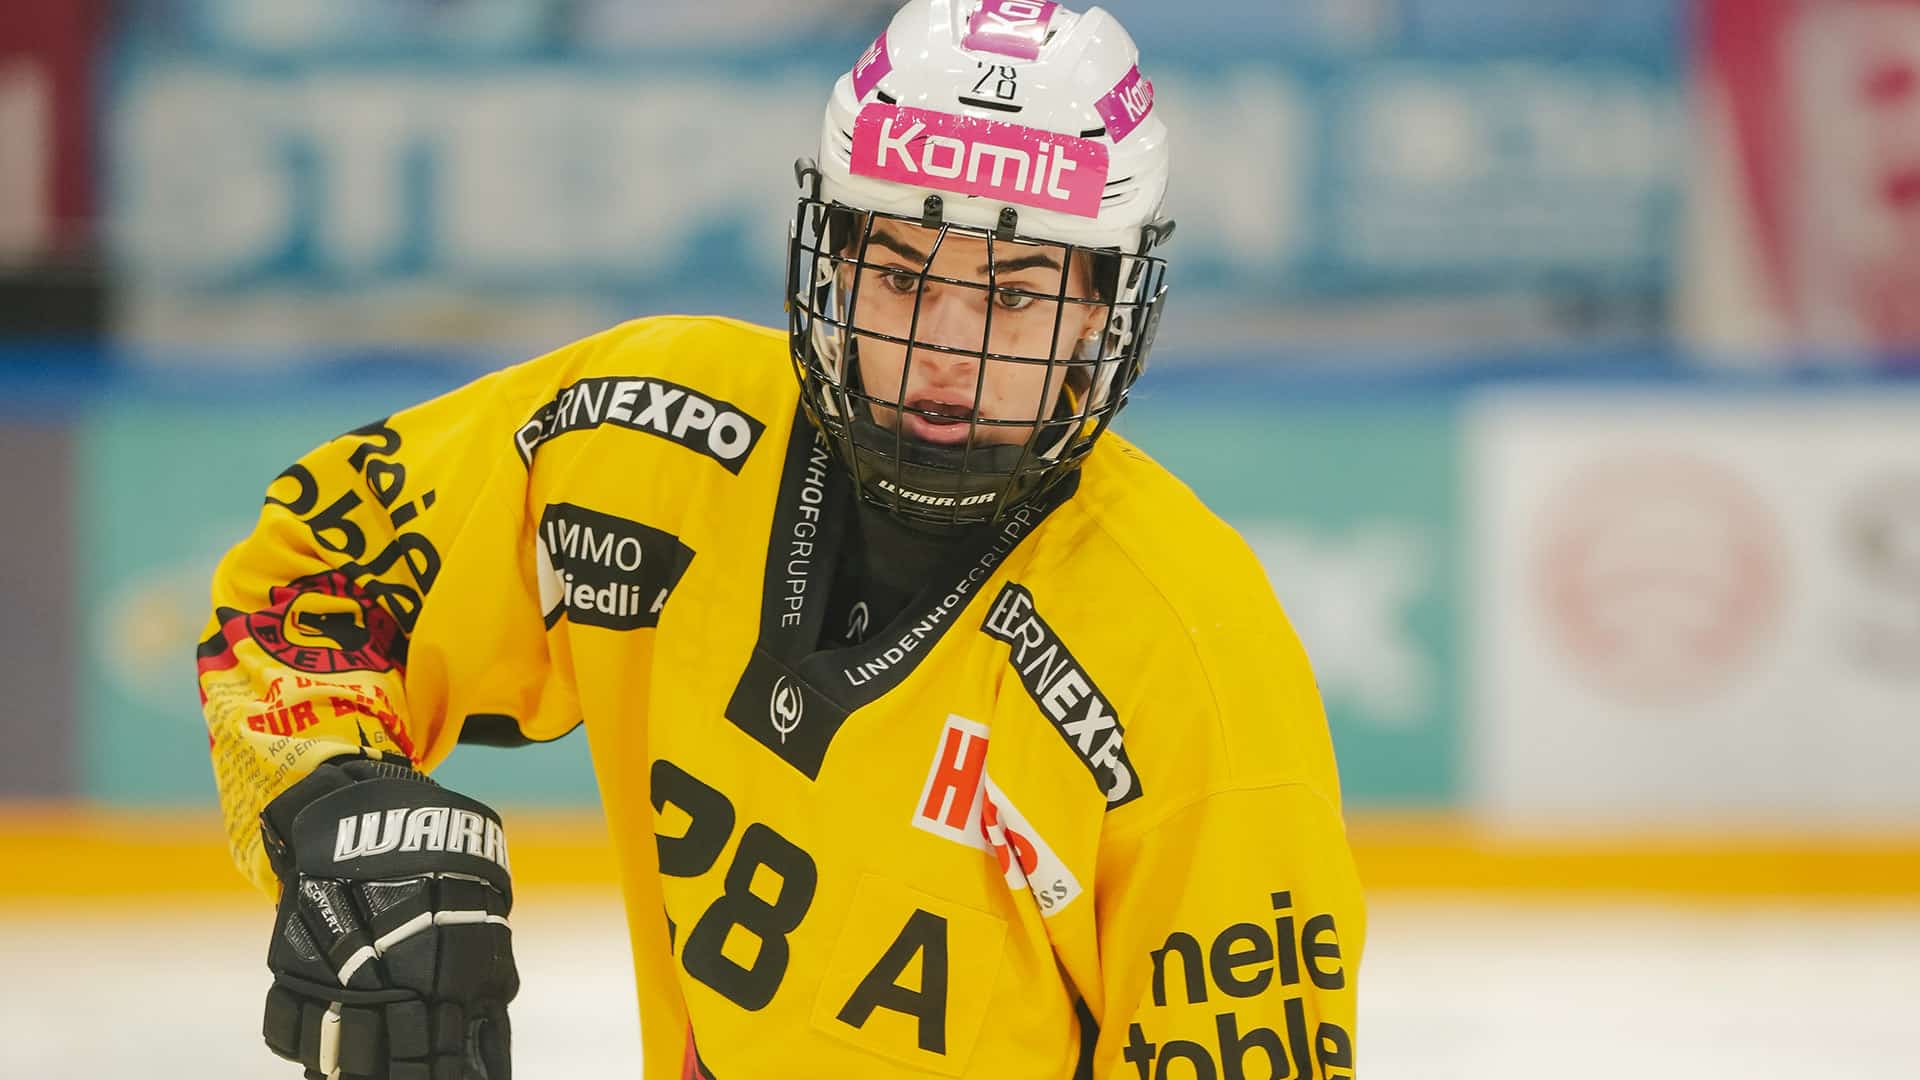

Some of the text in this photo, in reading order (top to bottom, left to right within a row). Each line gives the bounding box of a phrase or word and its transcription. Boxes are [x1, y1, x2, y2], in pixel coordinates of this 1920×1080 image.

[980, 0, 1045, 38] Ko
[972, 61, 1017, 101] 28
[876, 117, 1078, 201] Komit
[516, 381, 751, 466] BRNEXPO
[547, 519, 642, 572] IMMO
[557, 570, 640, 616] iedli
[247, 699, 320, 737] FÜR
[650, 759, 818, 1012] 28
[836, 908, 948, 1056] A
[1151, 890, 1345, 1007] neie
